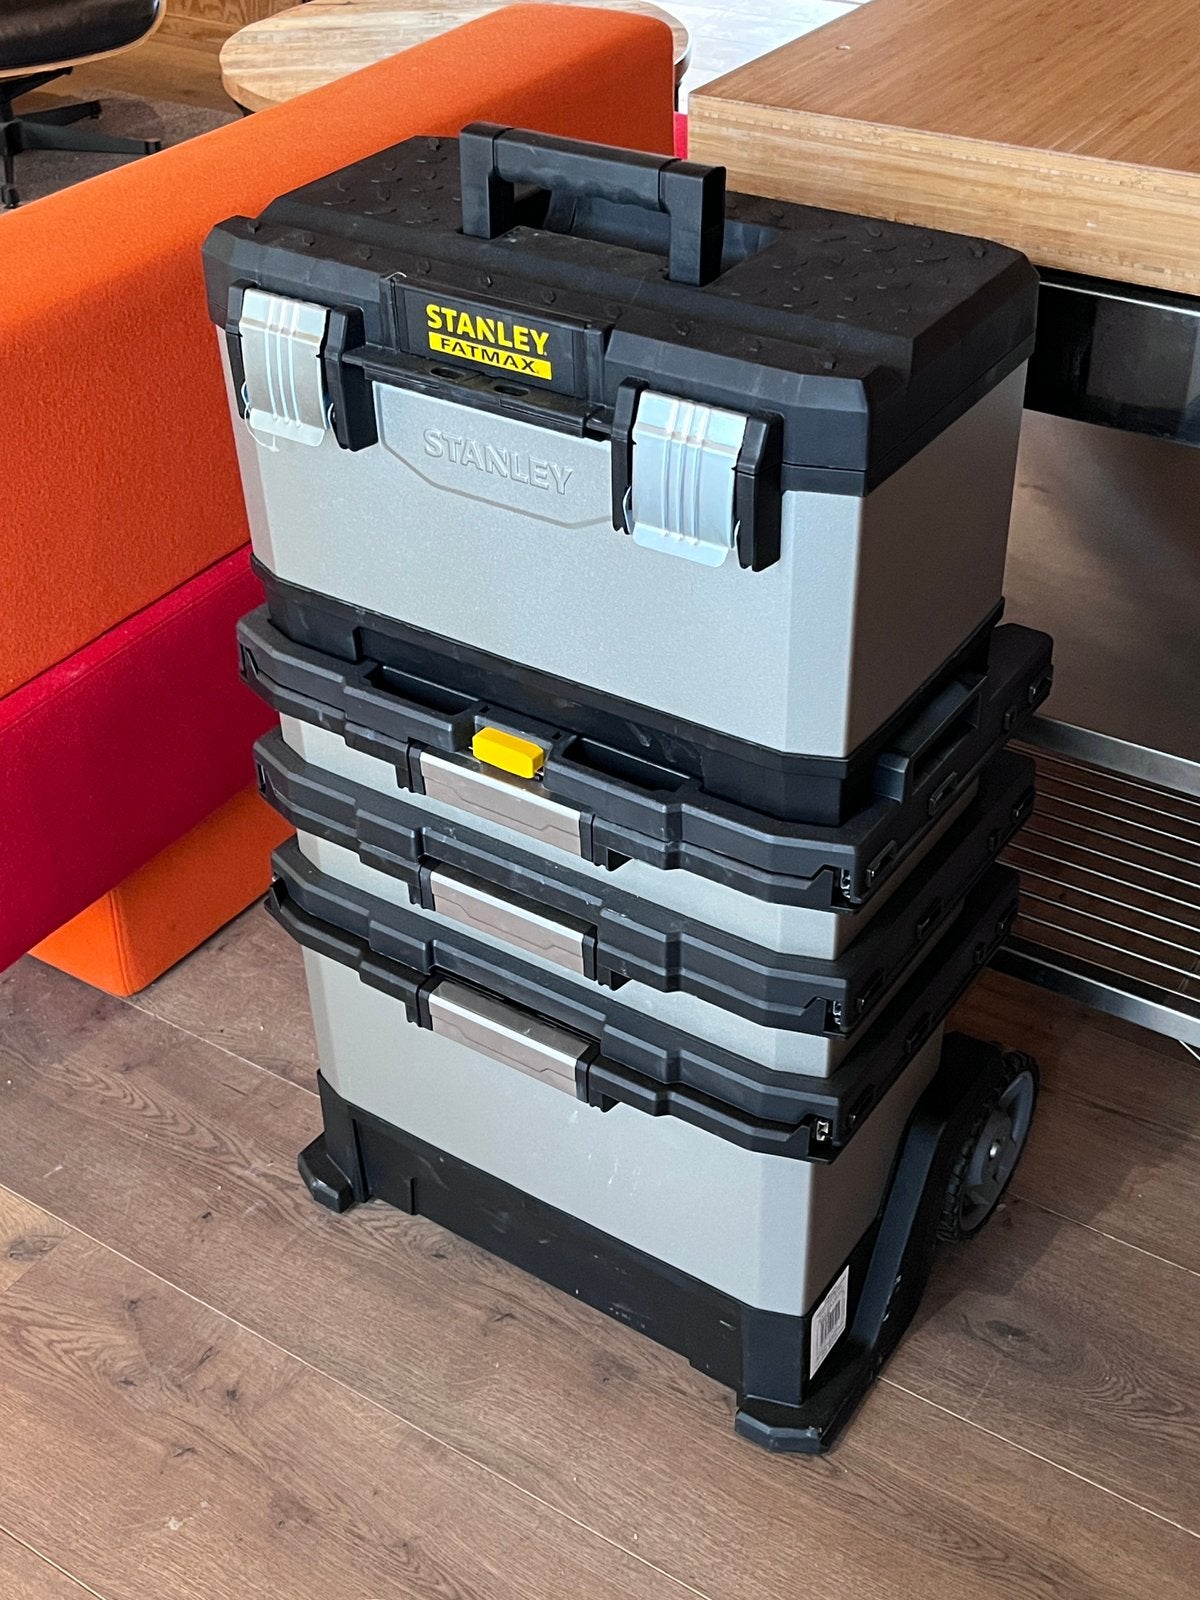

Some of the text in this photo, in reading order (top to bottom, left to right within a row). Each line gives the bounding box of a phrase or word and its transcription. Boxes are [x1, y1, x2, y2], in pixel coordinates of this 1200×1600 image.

[426, 304, 549, 356] STANLEY
[441, 337, 537, 374] FATMAX
[424, 428, 573, 495] STANLEY
